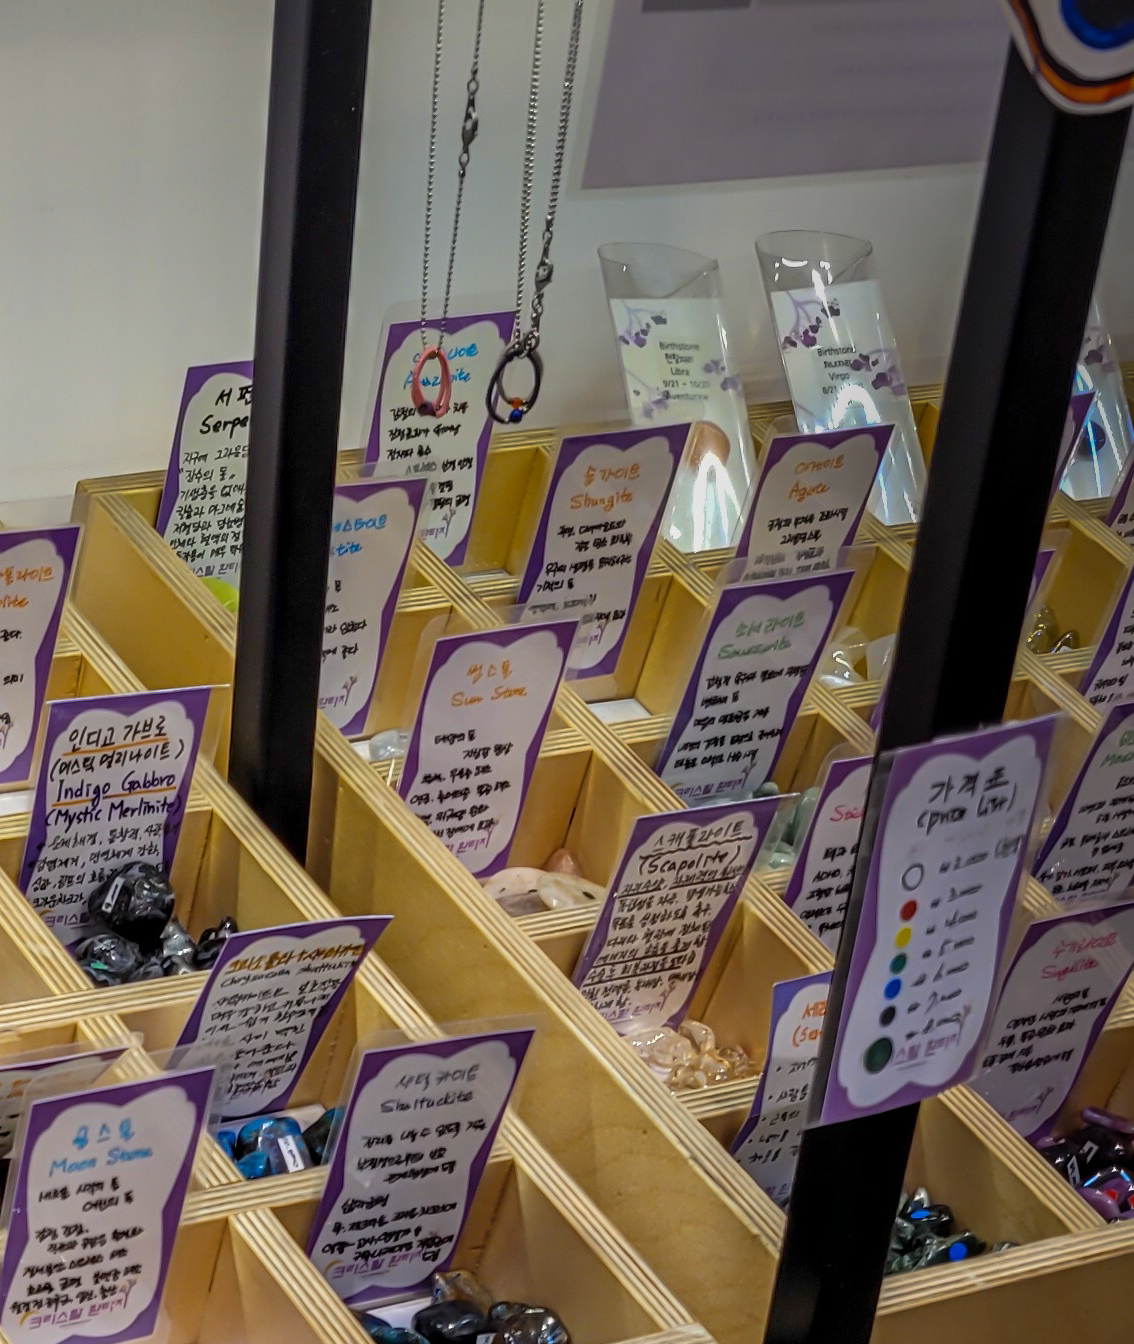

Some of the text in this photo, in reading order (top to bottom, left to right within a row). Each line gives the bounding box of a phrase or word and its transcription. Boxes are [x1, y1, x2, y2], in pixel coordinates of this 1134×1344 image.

[671, 366, 690, 376] Libra
[829, 371, 851, 382] Virgo
[69, 715, 167, 752] 인디고 가브로
[57, 770, 175, 806] Indigo Gabbro
[49, 1156, 97, 1177] Moon
